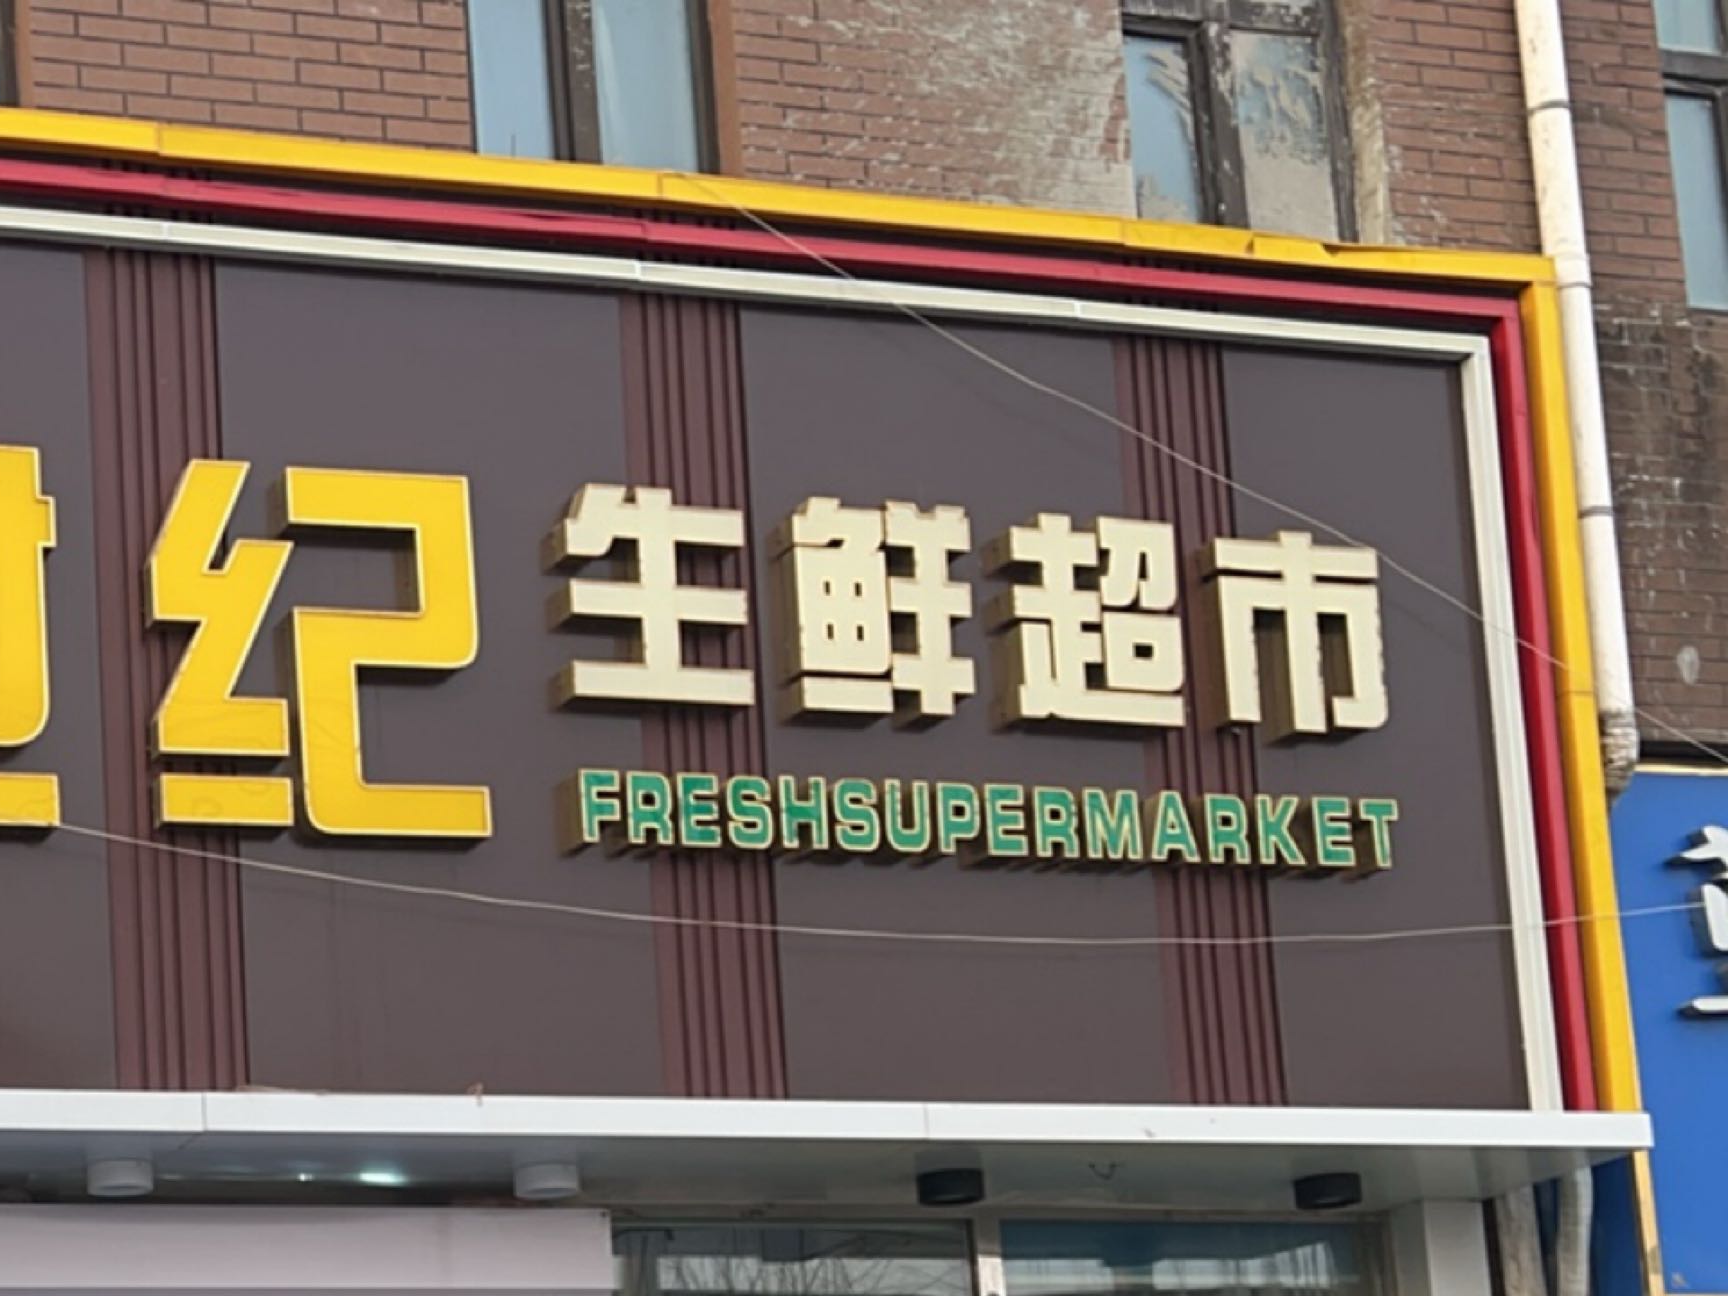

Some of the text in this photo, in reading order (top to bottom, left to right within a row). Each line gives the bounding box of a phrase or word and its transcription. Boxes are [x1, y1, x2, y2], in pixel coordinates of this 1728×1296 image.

[546, 483, 1388, 736] 生鲜超市
[577, 768, 1400, 869] FRESHSUPERMARKET
